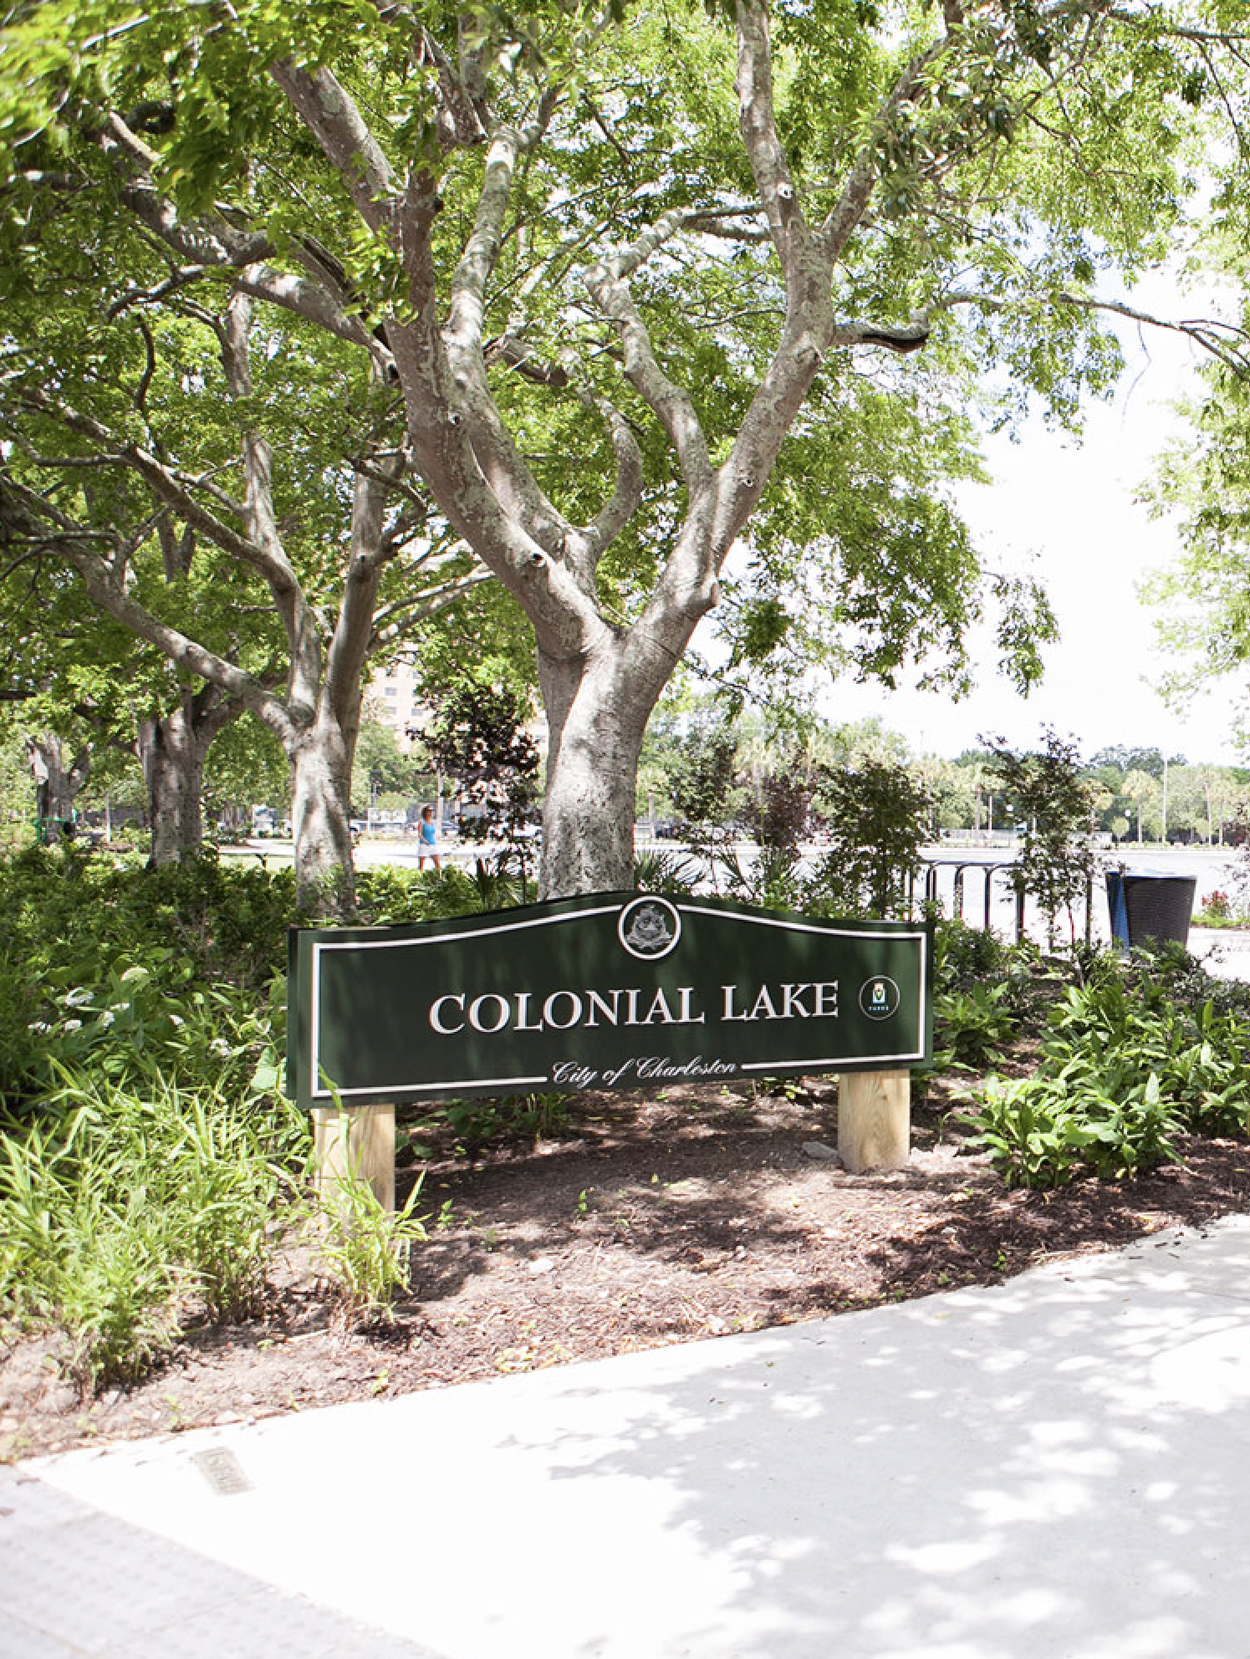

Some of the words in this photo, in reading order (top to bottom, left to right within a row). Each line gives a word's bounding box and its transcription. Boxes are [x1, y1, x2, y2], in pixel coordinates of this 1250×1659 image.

[429, 987, 705, 1034] COLONIAL
[721, 980, 839, 1022] LAKE
[552, 1062, 598, 1089] City
[602, 1058, 635, 1086] of
[636, 1055, 735, 1078] Charleston
